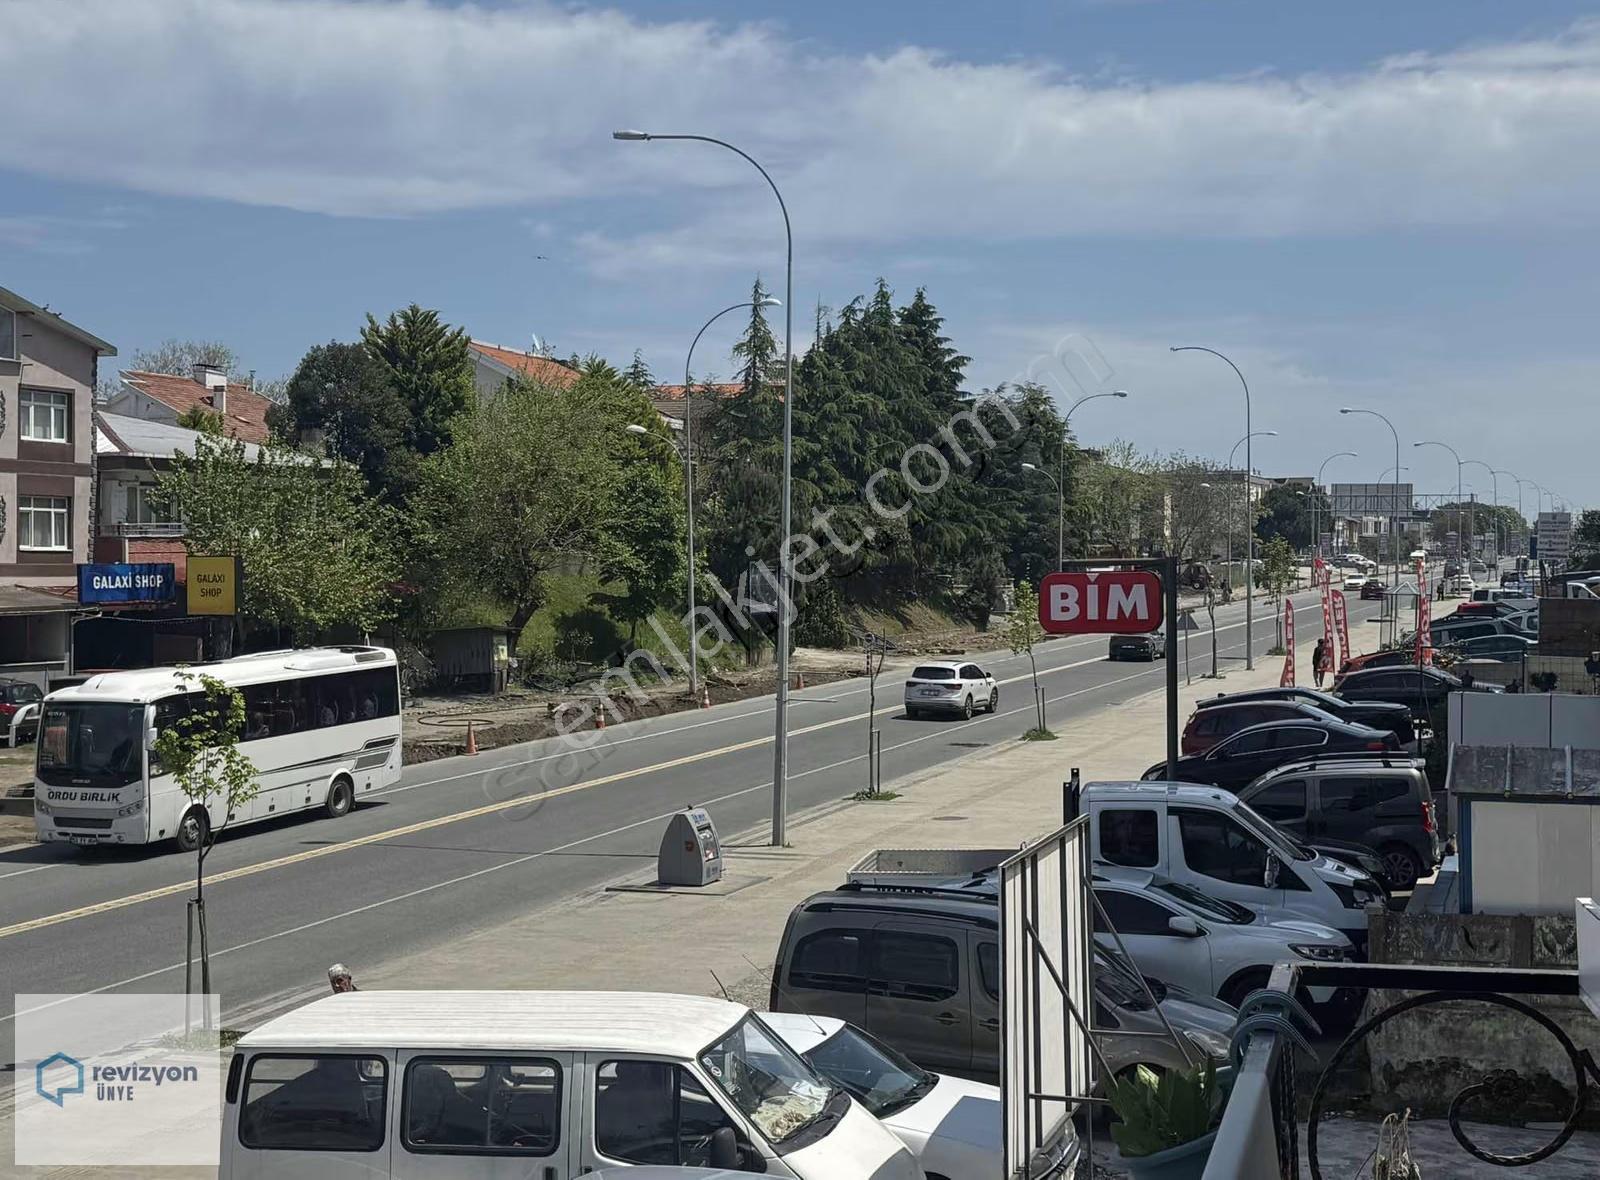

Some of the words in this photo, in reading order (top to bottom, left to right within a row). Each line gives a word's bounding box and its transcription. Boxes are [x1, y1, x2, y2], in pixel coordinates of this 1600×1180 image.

[134, 574, 165, 588] SHOP
[200, 587, 222, 598] SHOP
[47, 790, 78, 801] ORDU
